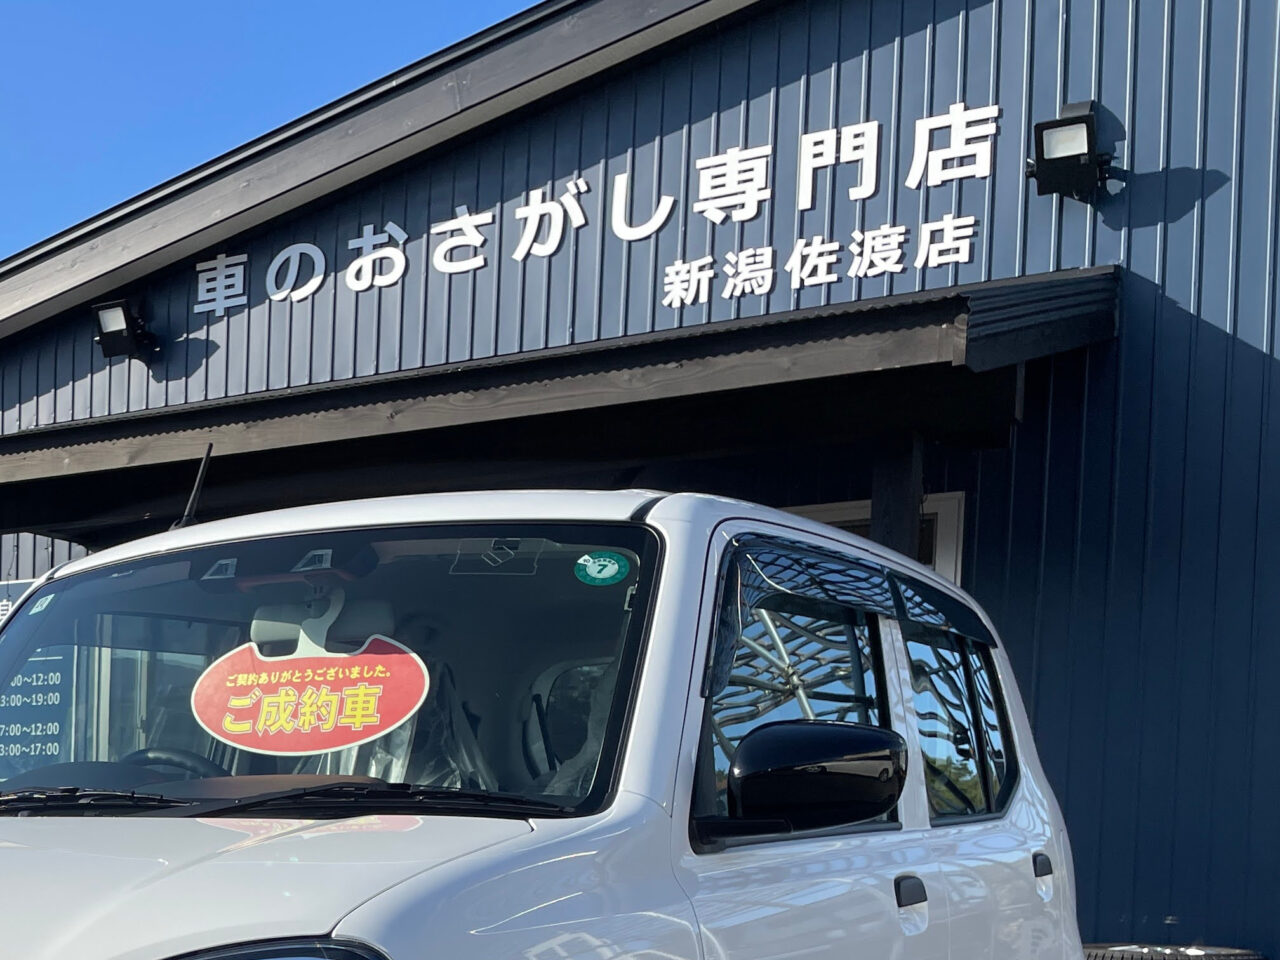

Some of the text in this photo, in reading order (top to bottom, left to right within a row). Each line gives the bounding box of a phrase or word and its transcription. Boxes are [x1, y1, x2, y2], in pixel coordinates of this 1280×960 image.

[193, 102, 1000, 317] 車のおさがし専門店
[662, 213, 977, 309] 新潟佐渡店
[597, 563, 608, 574] 7
[222, 683, 383, 736] ご成約車
